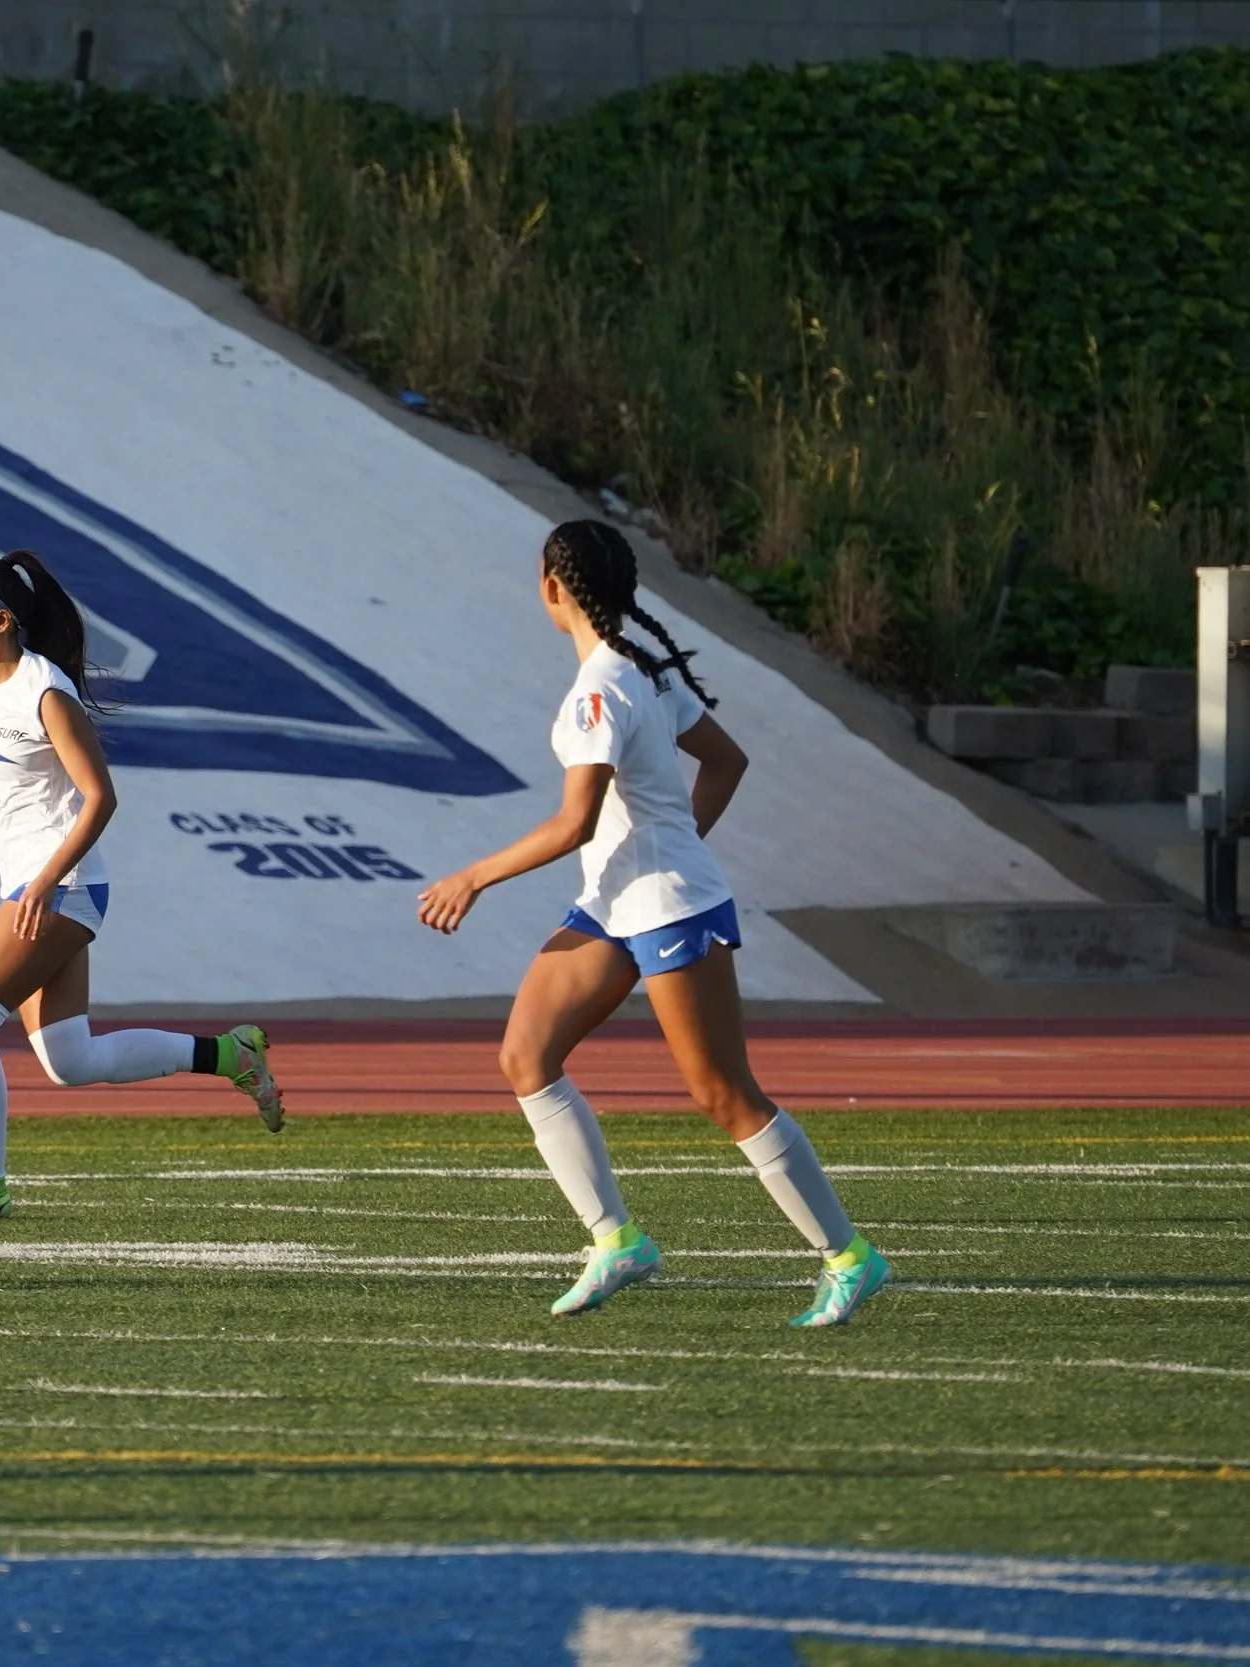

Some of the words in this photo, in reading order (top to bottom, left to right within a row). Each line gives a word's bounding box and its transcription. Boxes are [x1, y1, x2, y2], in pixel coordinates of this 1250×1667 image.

[168, 811, 302, 837] CLASS
[303, 814, 356, 838] OF
[206, 841, 425, 882] 2015
